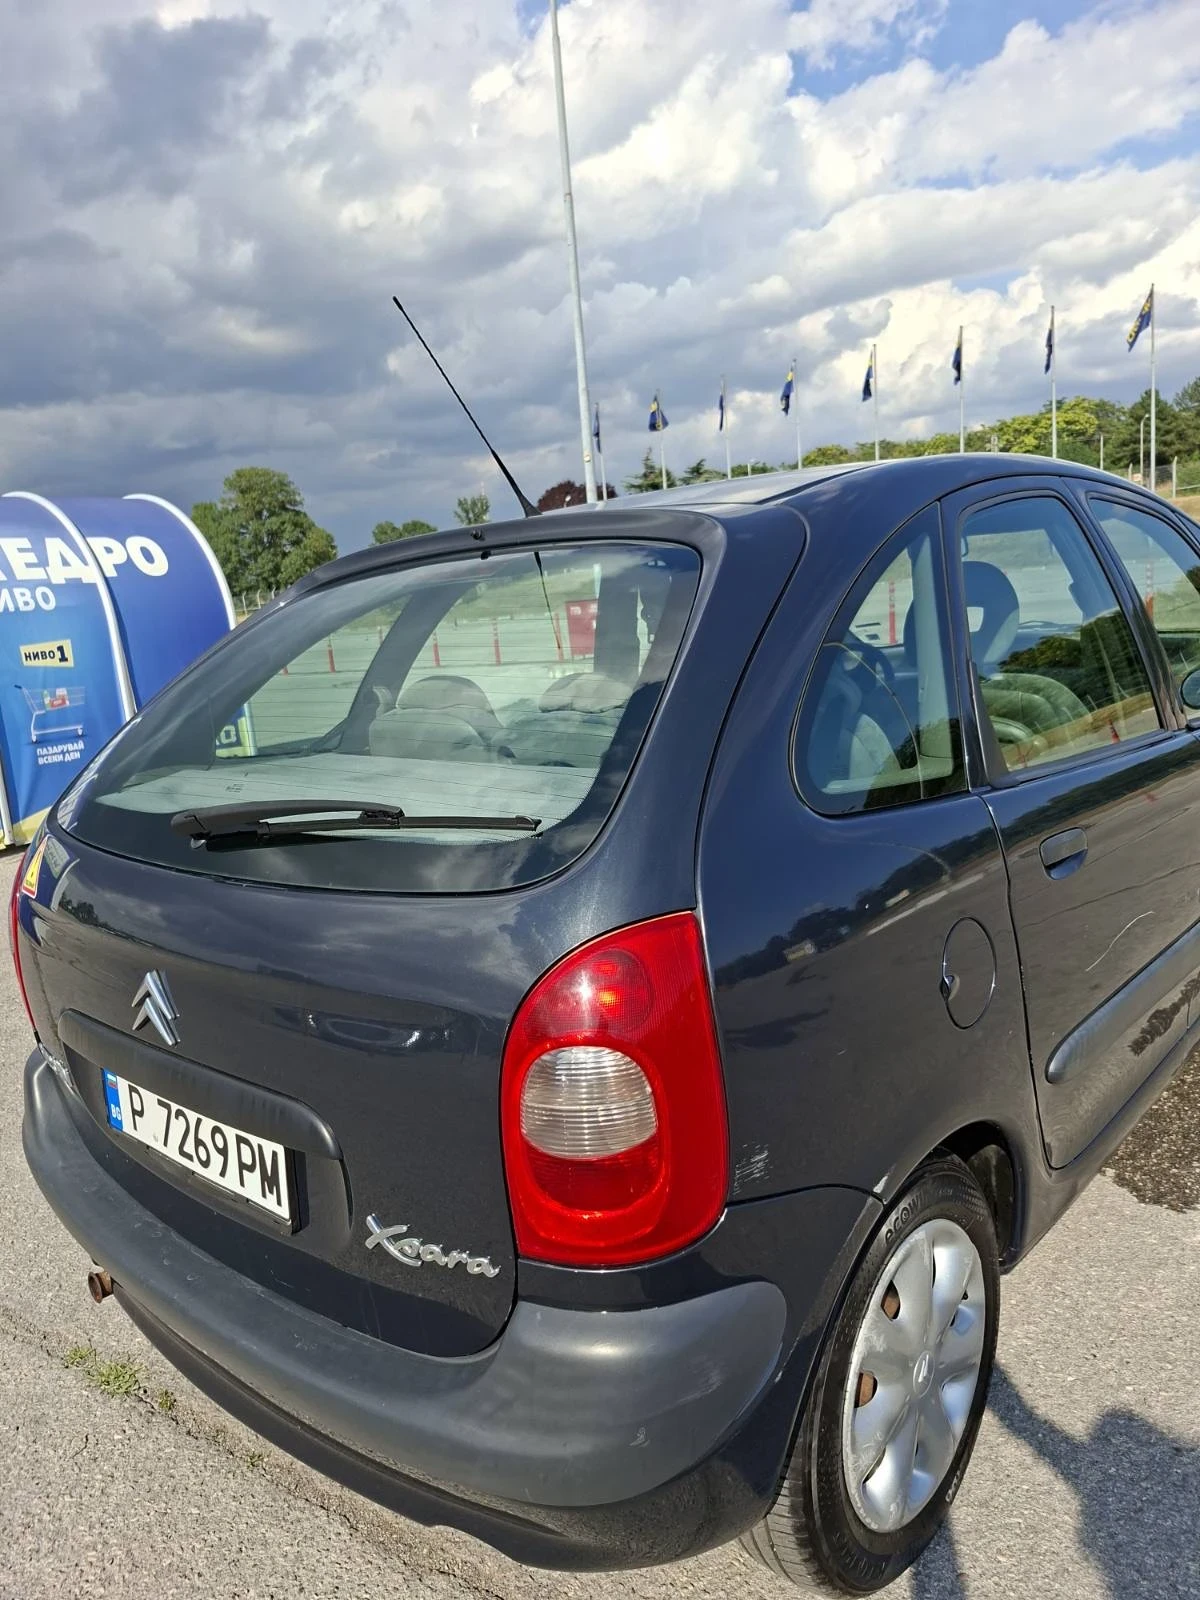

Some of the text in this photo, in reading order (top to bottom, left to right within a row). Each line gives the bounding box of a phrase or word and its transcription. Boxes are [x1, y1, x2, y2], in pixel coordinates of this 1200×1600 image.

[0, 535, 169, 585] ЕДРО
[24, 645, 69, 663] НИВО 1
[36, 740, 85, 756] ПАЗАРУВАЙ
[38, 751, 81, 765] ВСЕКИ ДЕН
[110, 1103, 122, 1121] BG
[364, 1212, 502, 1279] Xsara
